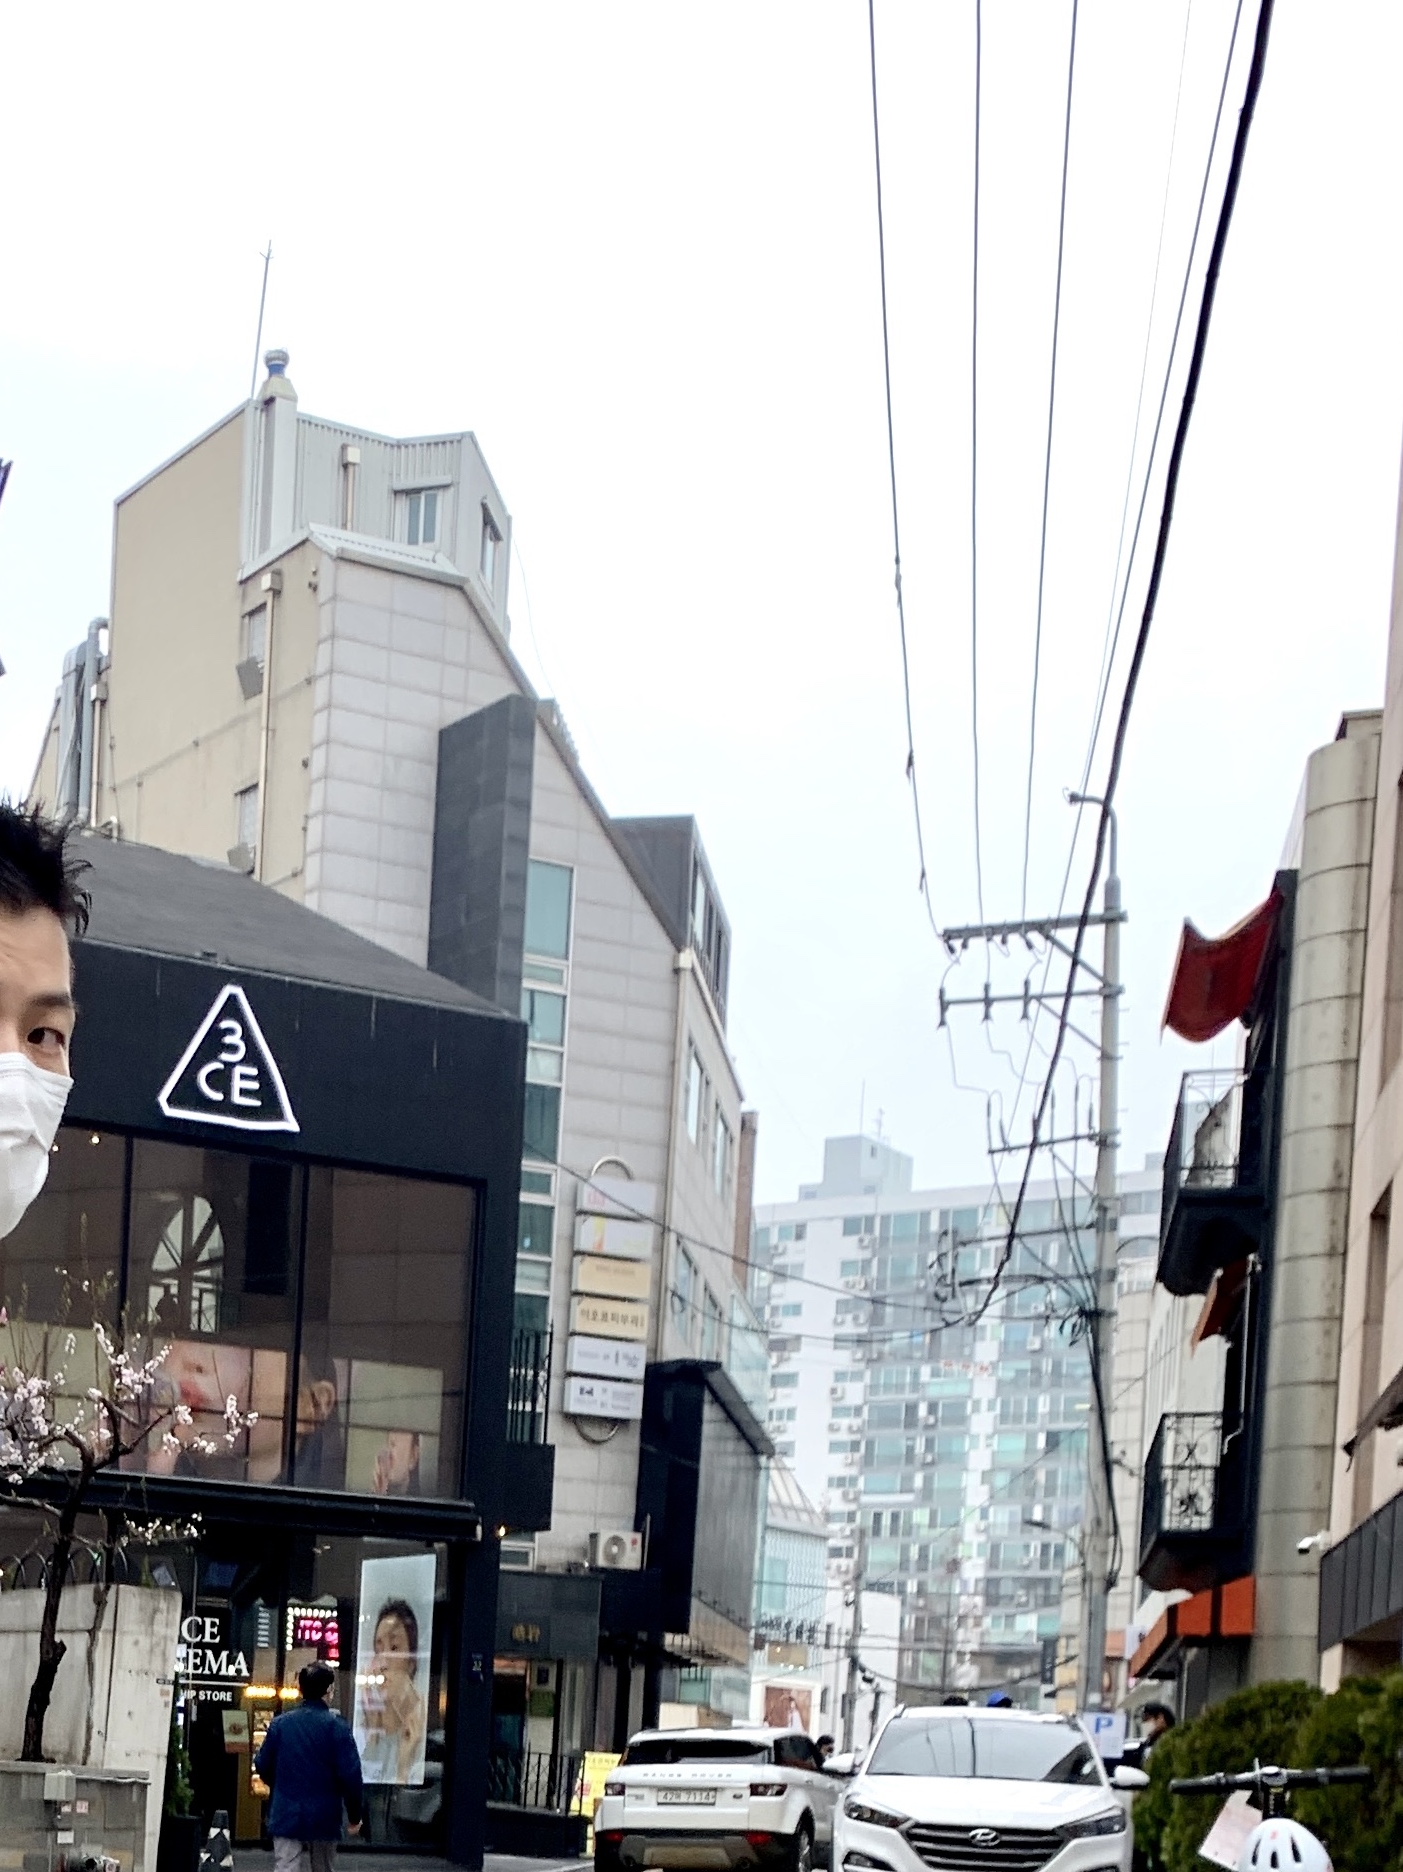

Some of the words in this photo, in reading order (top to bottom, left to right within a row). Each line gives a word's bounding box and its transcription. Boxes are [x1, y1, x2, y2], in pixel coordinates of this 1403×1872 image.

[218, 1019, 247, 1063] 3
[197, 1061, 263, 1107] CE
[199, 1690, 233, 1702] STORE
[1095, 1716, 1113, 1734] P
